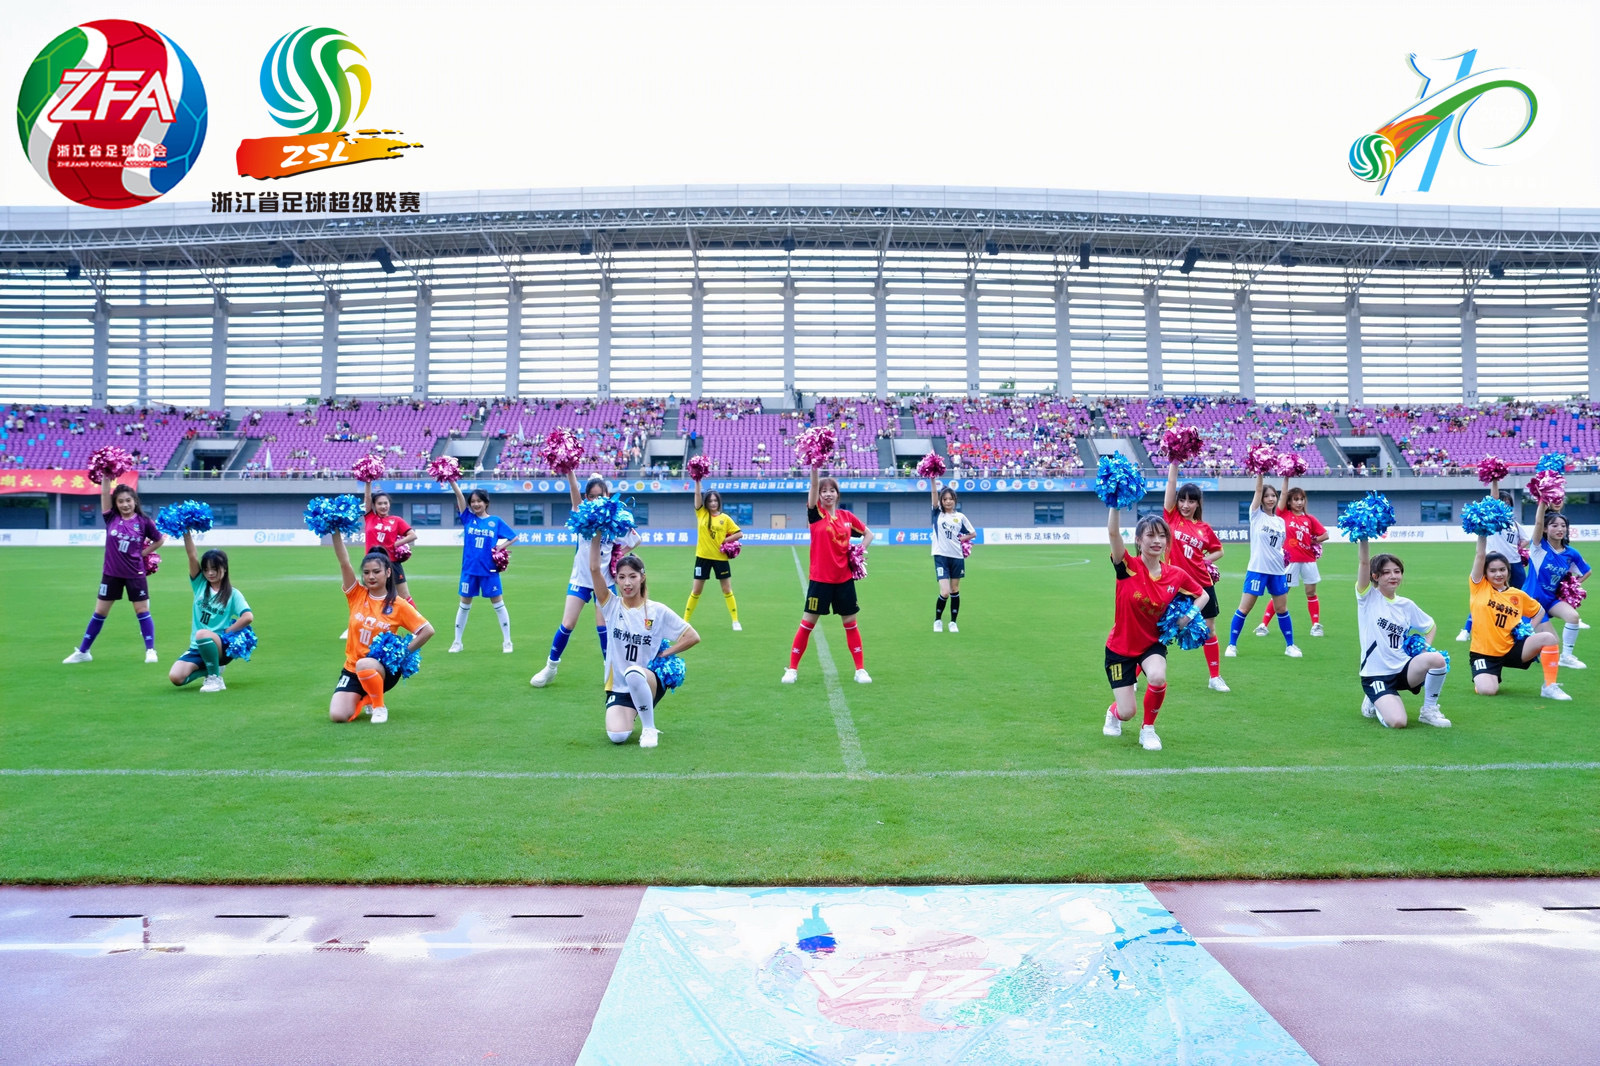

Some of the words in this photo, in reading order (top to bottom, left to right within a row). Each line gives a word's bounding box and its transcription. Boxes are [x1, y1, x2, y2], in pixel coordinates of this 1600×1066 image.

[474, 536, 485, 549] 10
[1004, 531, 1071, 541] 杭州市足球协会
[1269, 535, 1278, 548] 10
[1506, 532, 1515, 544] 10
[118, 539, 130, 553] 10
[1183, 544, 1194, 559] 10
[1251, 579, 1261, 592] 10
[808, 596, 819, 611] 10
[200, 610, 212, 626] 10
[1495, 613, 1508, 629] 10
[359, 628, 372, 646] 10
[613, 628, 652, 646] 衢州信安
[1387, 633, 1401, 649] 10
[624, 644, 638, 662] 10
[1109, 663, 1123, 681] 10
[1474, 658, 1487, 671] 10
[1369, 680, 1386, 695] 10
